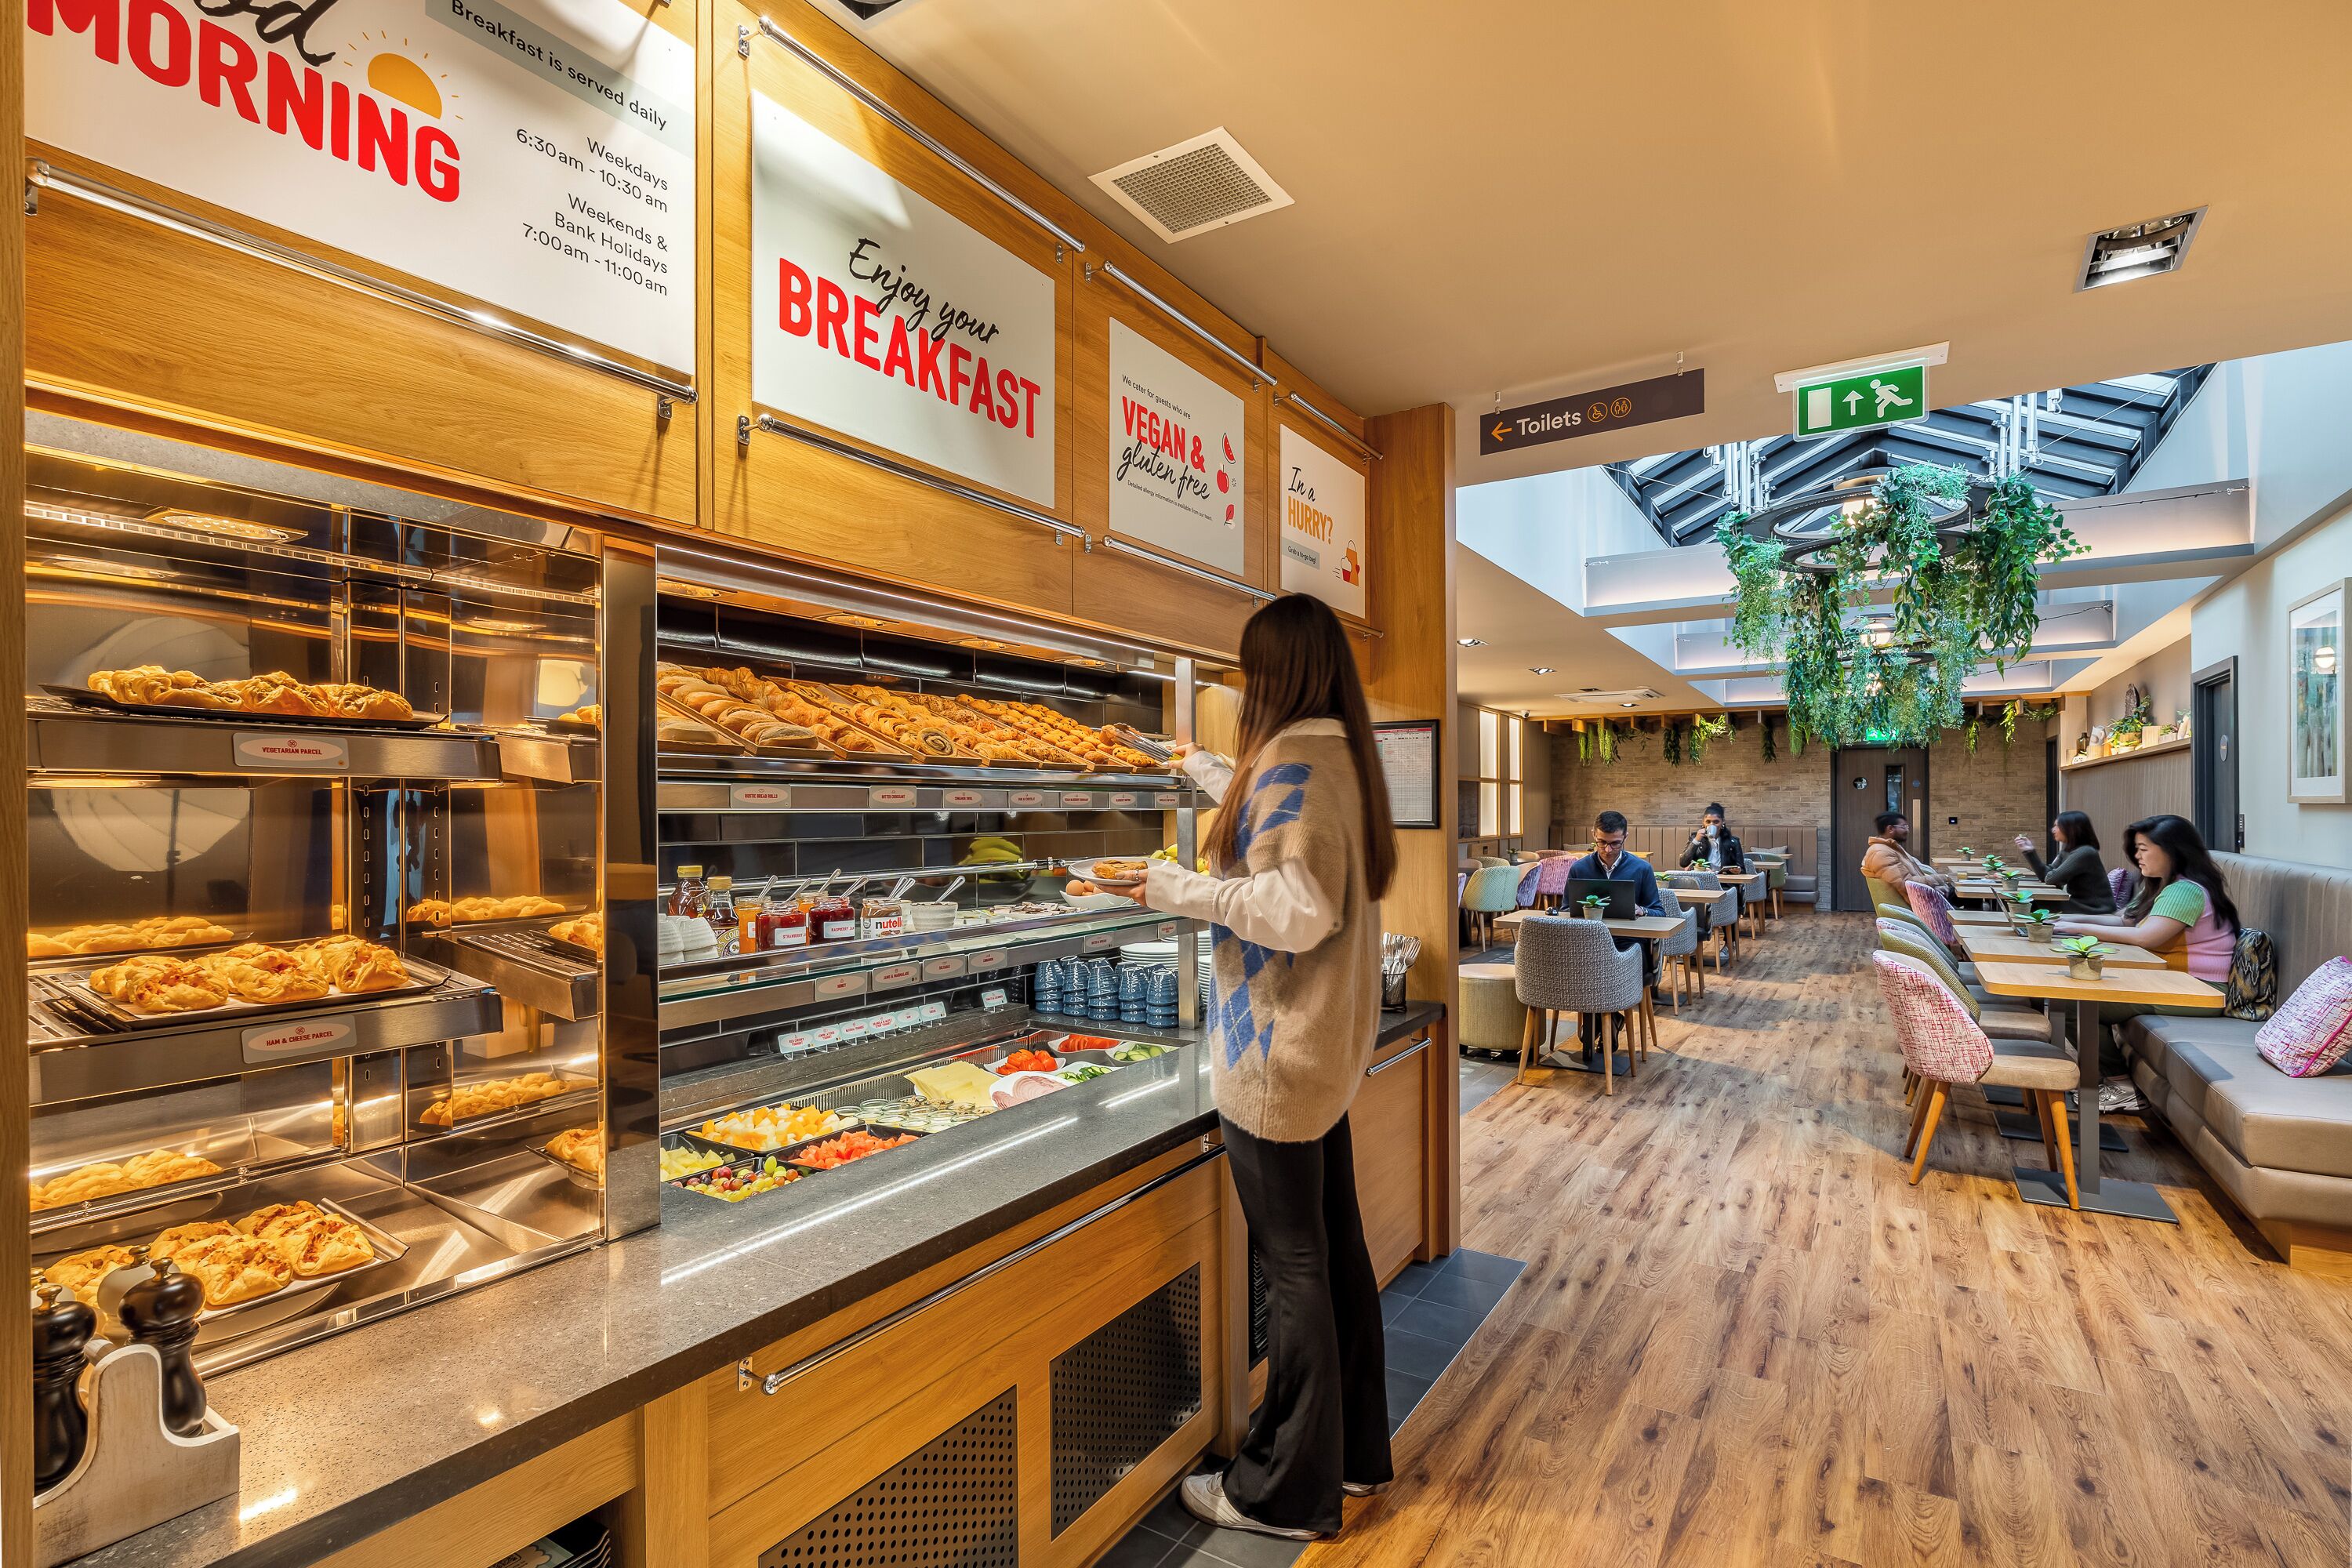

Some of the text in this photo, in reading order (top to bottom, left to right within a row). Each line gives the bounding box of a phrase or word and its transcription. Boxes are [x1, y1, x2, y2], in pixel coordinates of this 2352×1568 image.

[452, 0, 666, 131] Breakfast is served daily
[587, 136, 667, 191] Weekdays
[555, 212, 667, 274] Bank Holidays
[568, 193, 668, 252] Weekends &
[848, 237, 999, 344] Enjoy your
[779, 256, 1041, 439] BREAKFAST
[1122, 374, 1131, 386] We
[1133, 382, 1146, 394] cater
[1146, 389, 1155, 399] for
[1155, 395, 1171, 408] guests
[1172, 405, 1182, 415] who
[1122, 395, 1206, 474] VEGAN &
[1516, 411, 1581, 436] Toilets
[1116, 439, 1210, 499] gluten free
[1127, 480, 1142, 491] Detailed
[1143, 488, 1154, 497] allergy
[1155, 492, 1174, 504] information
[1288, 466, 1316, 502] In a
[1288, 495, 1333, 545] HURRY?
[1287, 546, 1297, 555] Grab
[1299, 550, 1309, 561] to-go
[267, 1038, 280, 1047] HAM
[289, 1034, 311, 1043] CHEESE
